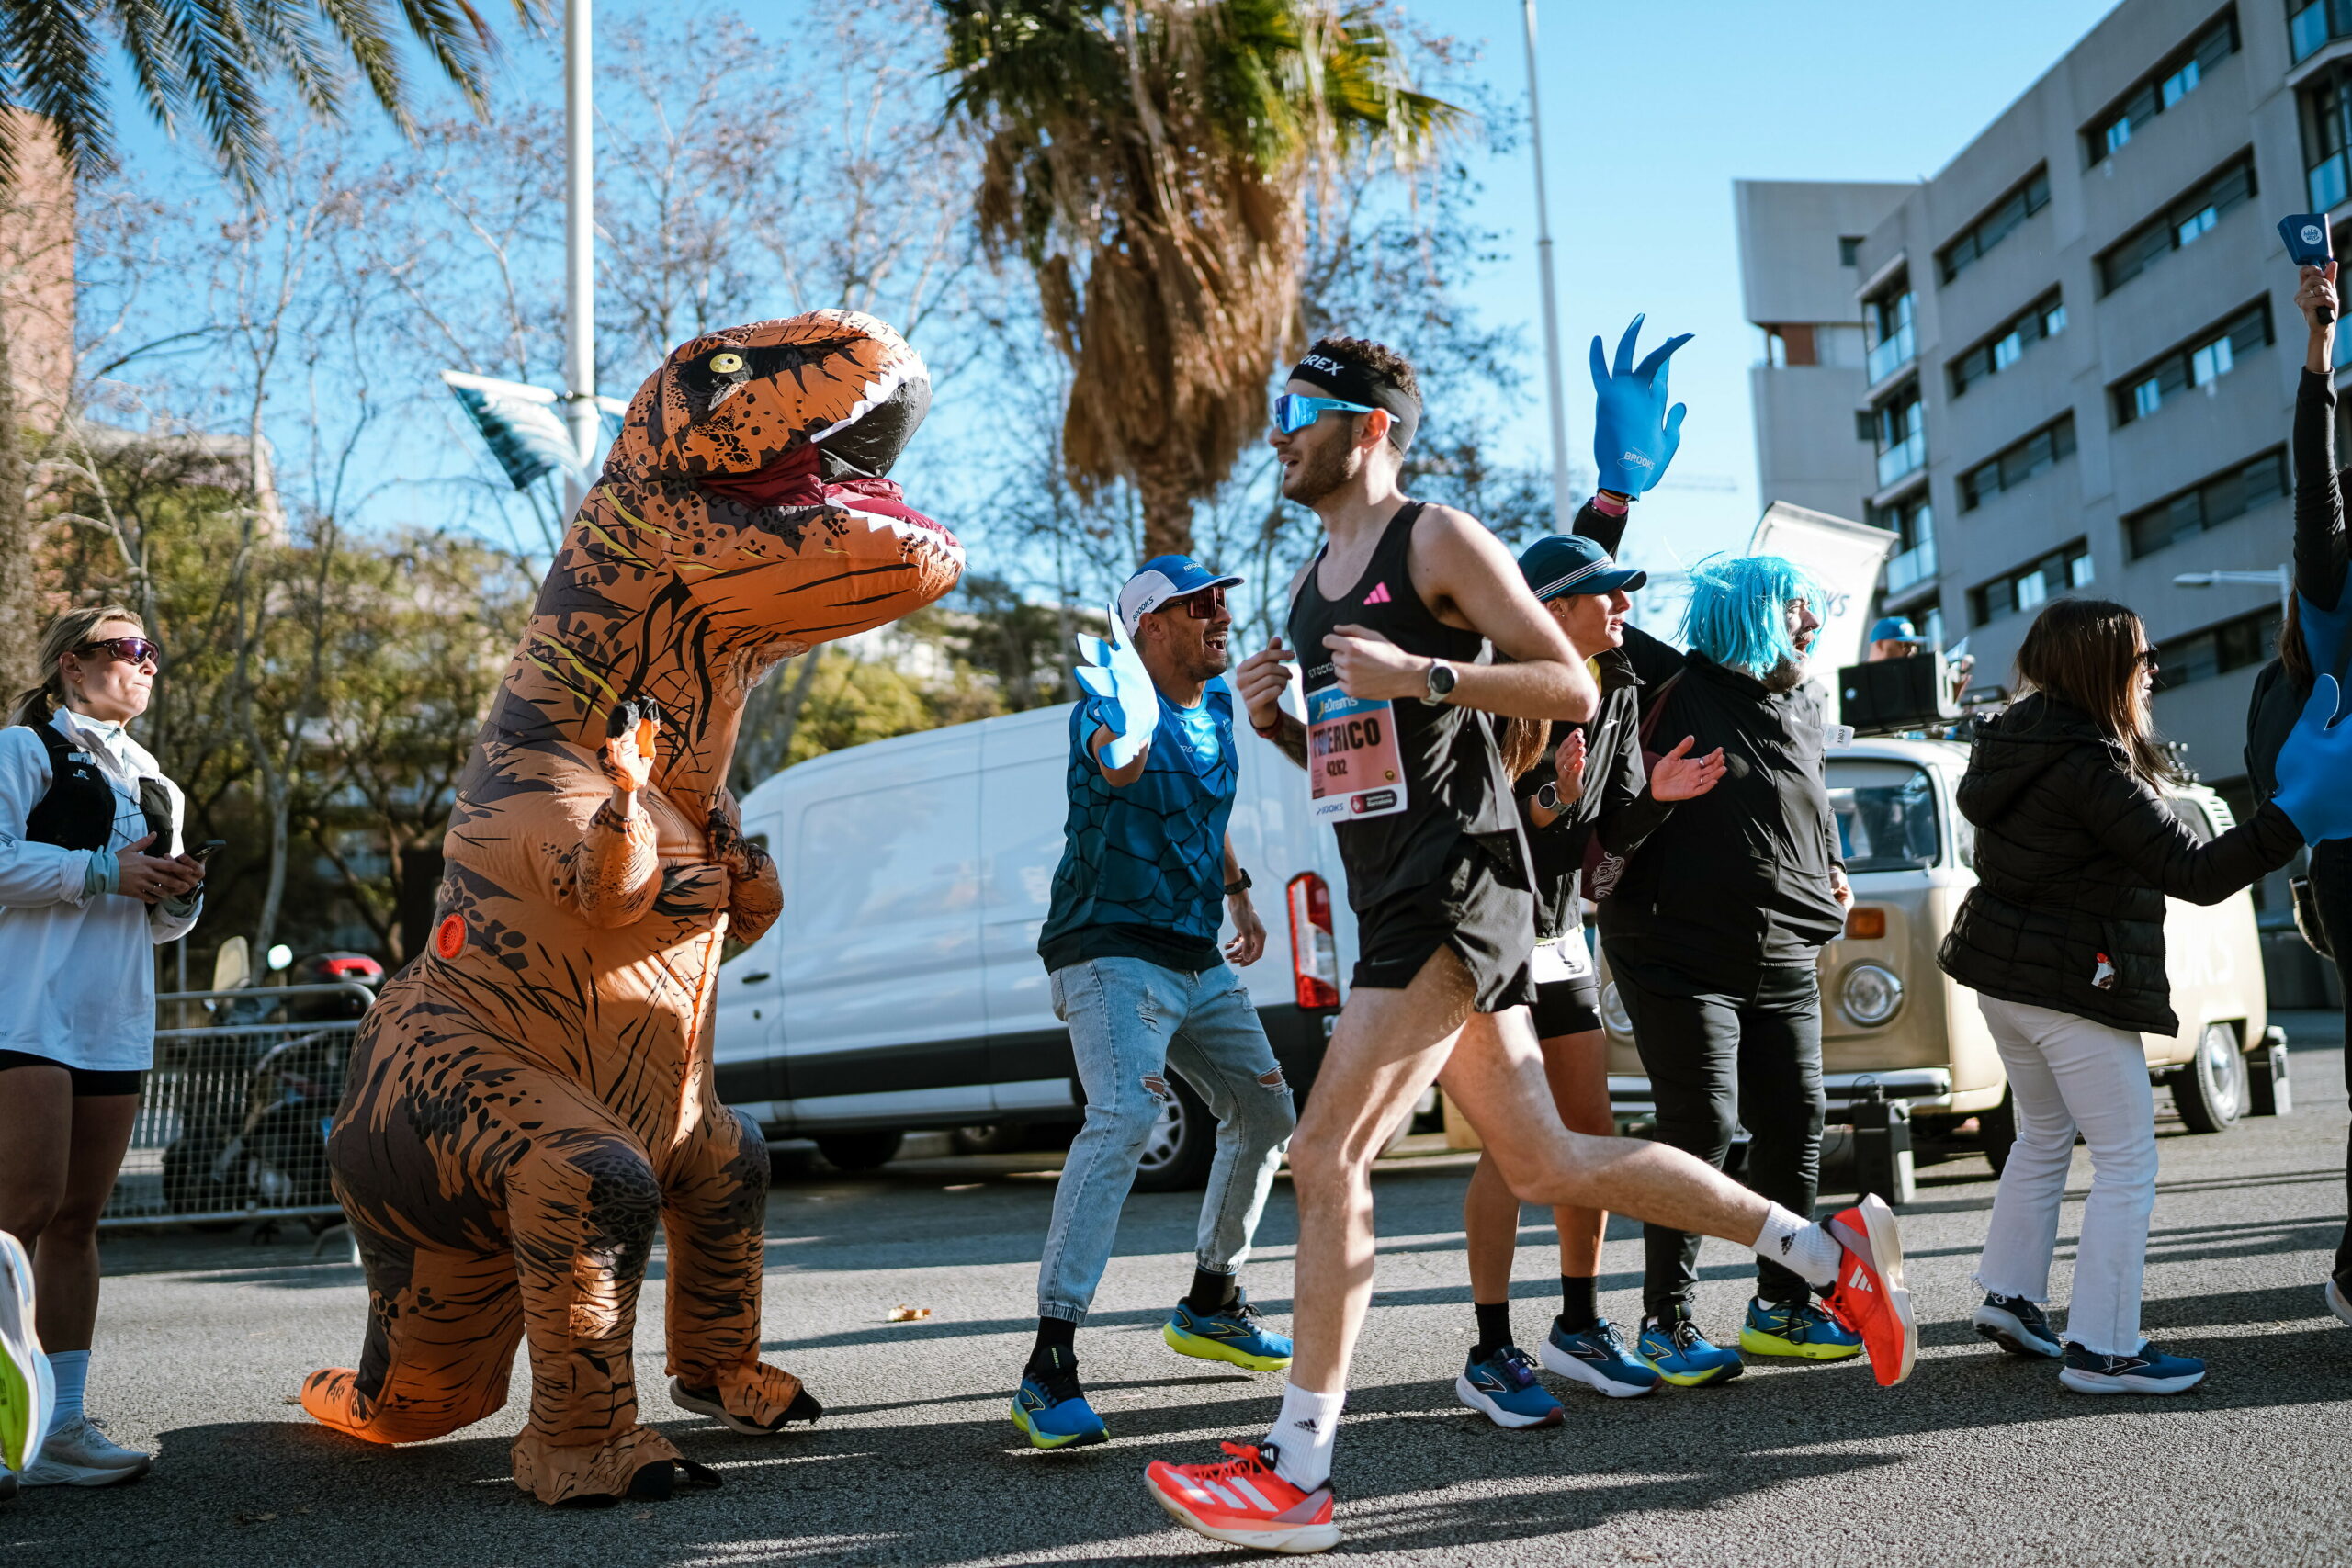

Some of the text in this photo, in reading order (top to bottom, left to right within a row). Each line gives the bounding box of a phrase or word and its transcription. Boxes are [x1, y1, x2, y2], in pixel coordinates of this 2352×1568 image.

[1623, 451, 1656, 470] BROOKS
[1132, 595, 1154, 623] BROOKS
[1326, 758, 1349, 777] 4282
